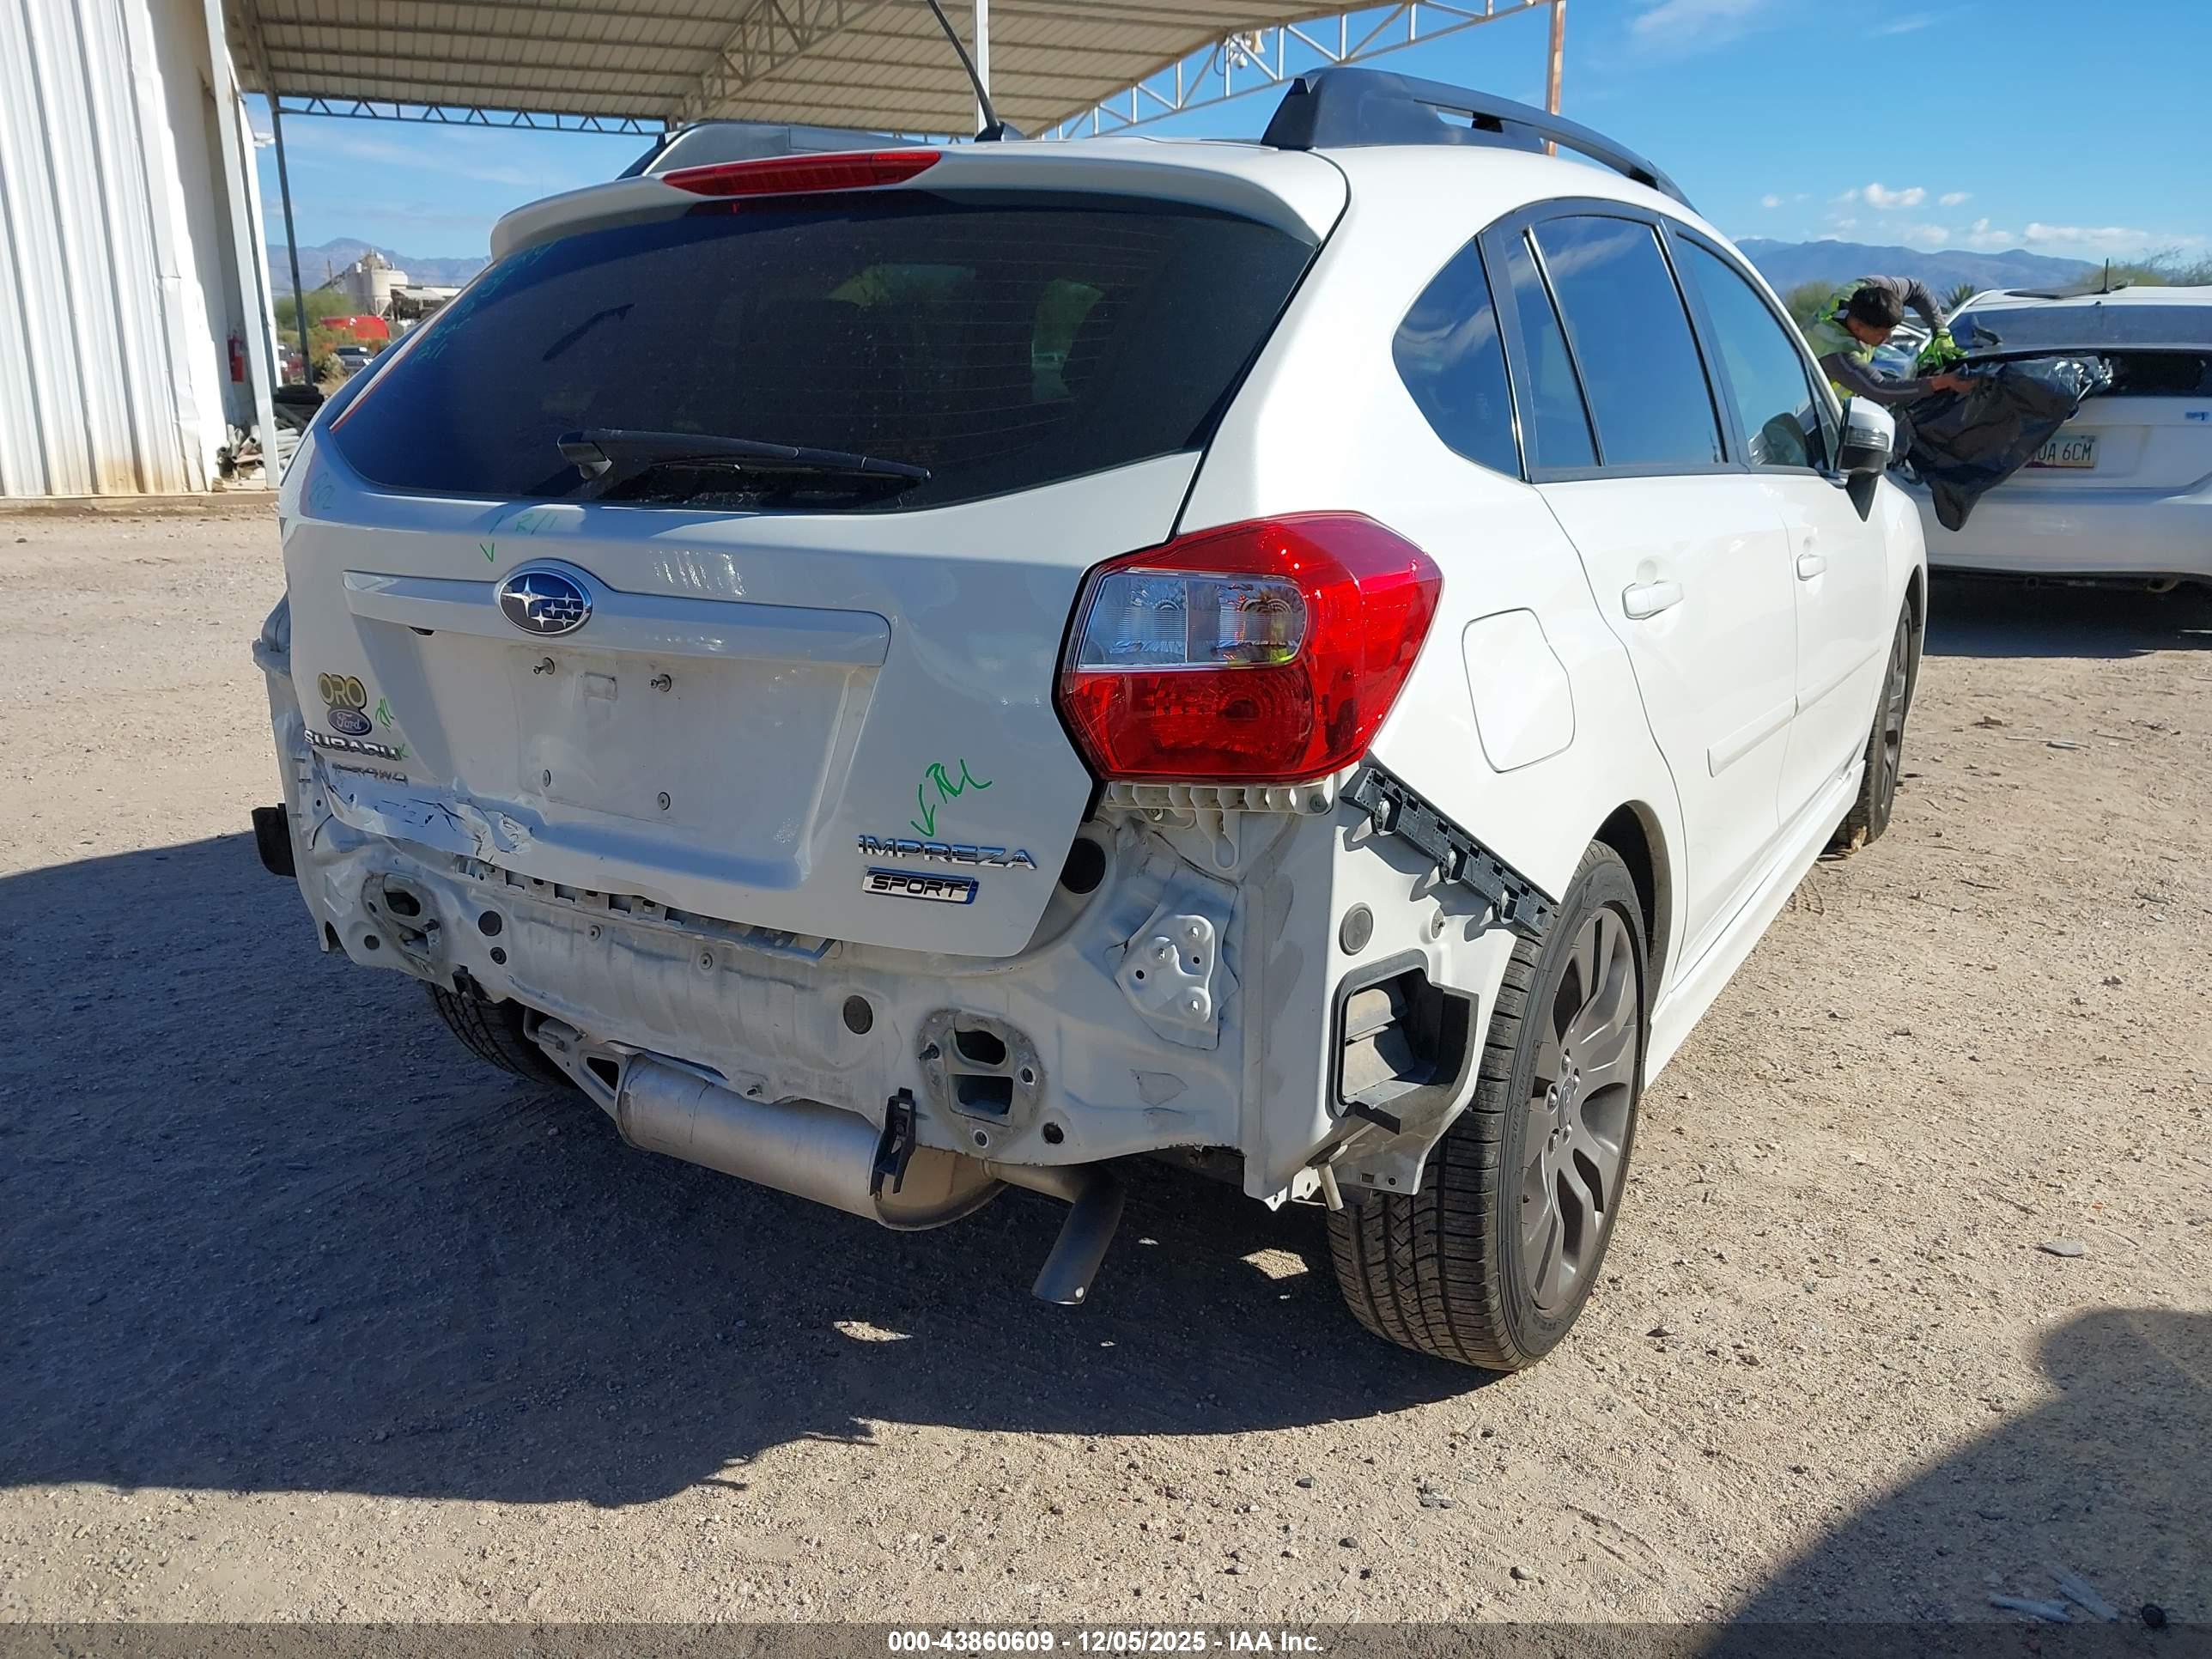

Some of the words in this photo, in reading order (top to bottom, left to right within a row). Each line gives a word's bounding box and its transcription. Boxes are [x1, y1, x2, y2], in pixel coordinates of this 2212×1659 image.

[2062, 443, 2093, 460] 6CM
[318, 672, 367, 708] ORO
[337, 712, 362, 730] Ford
[304, 728, 402, 761] SUBARU
[857, 834, 1038, 871] IMPREZA
[871, 873, 969, 898] SPORT
